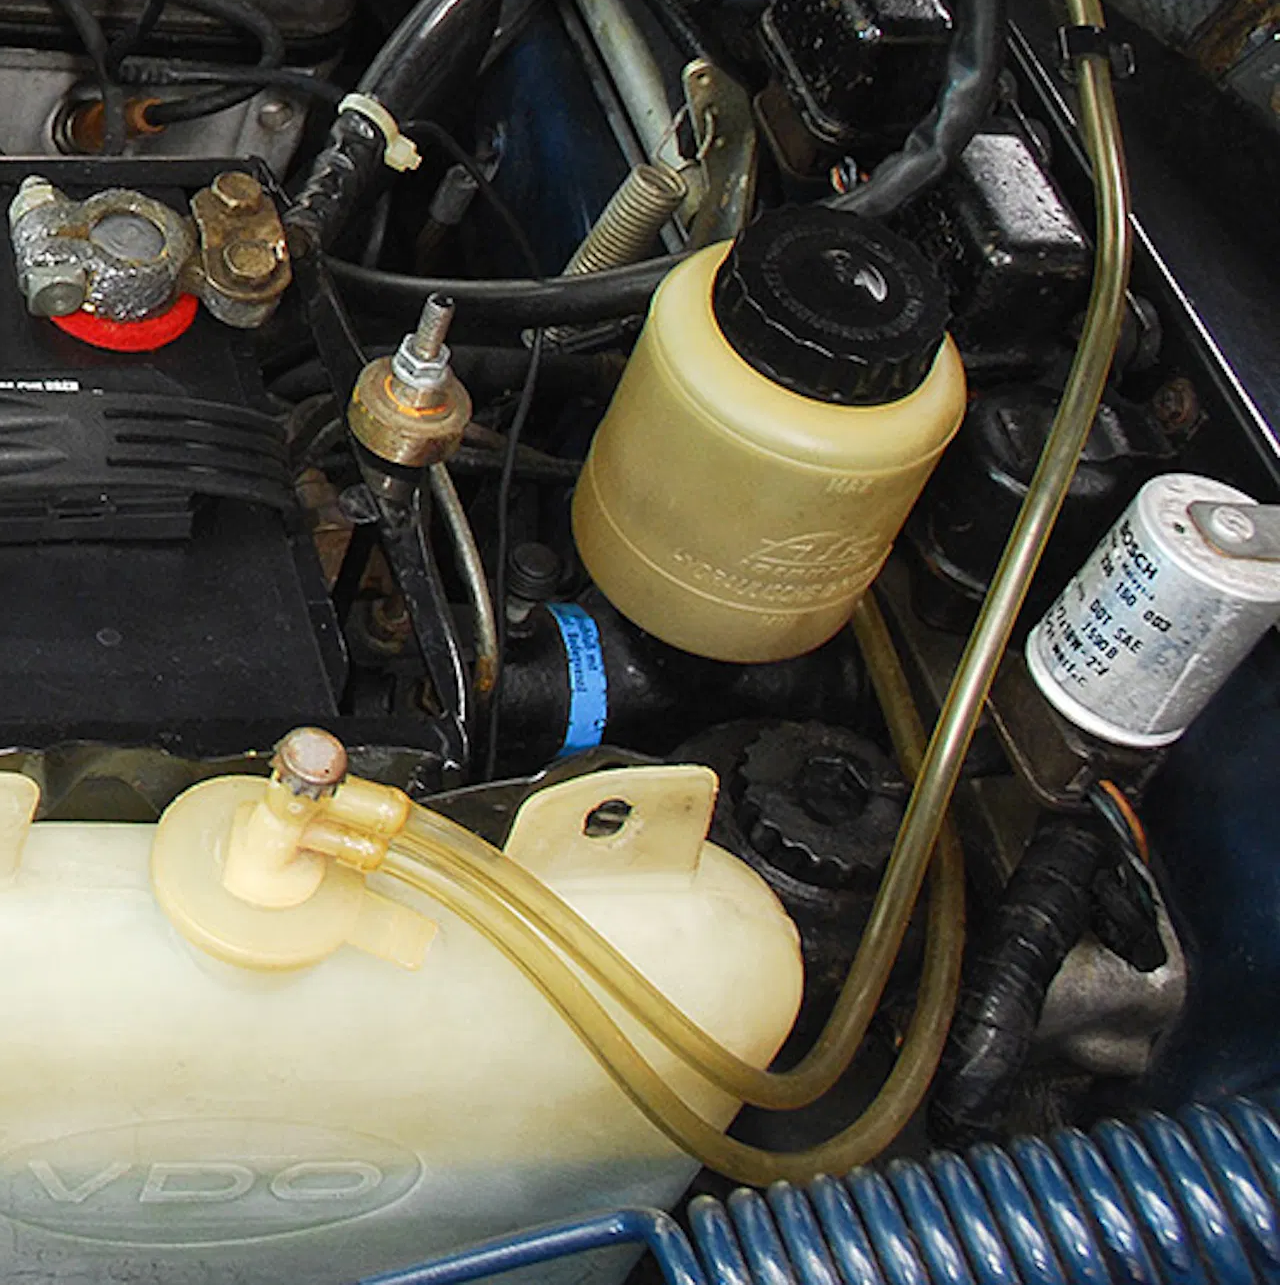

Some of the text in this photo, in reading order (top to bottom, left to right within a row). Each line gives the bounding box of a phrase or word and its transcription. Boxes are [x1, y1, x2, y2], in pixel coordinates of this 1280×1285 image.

[1119, 519, 1159, 580] BOSCH
[1113, 626, 1145, 655] SAE
[27, 1159, 384, 1204] VDO
